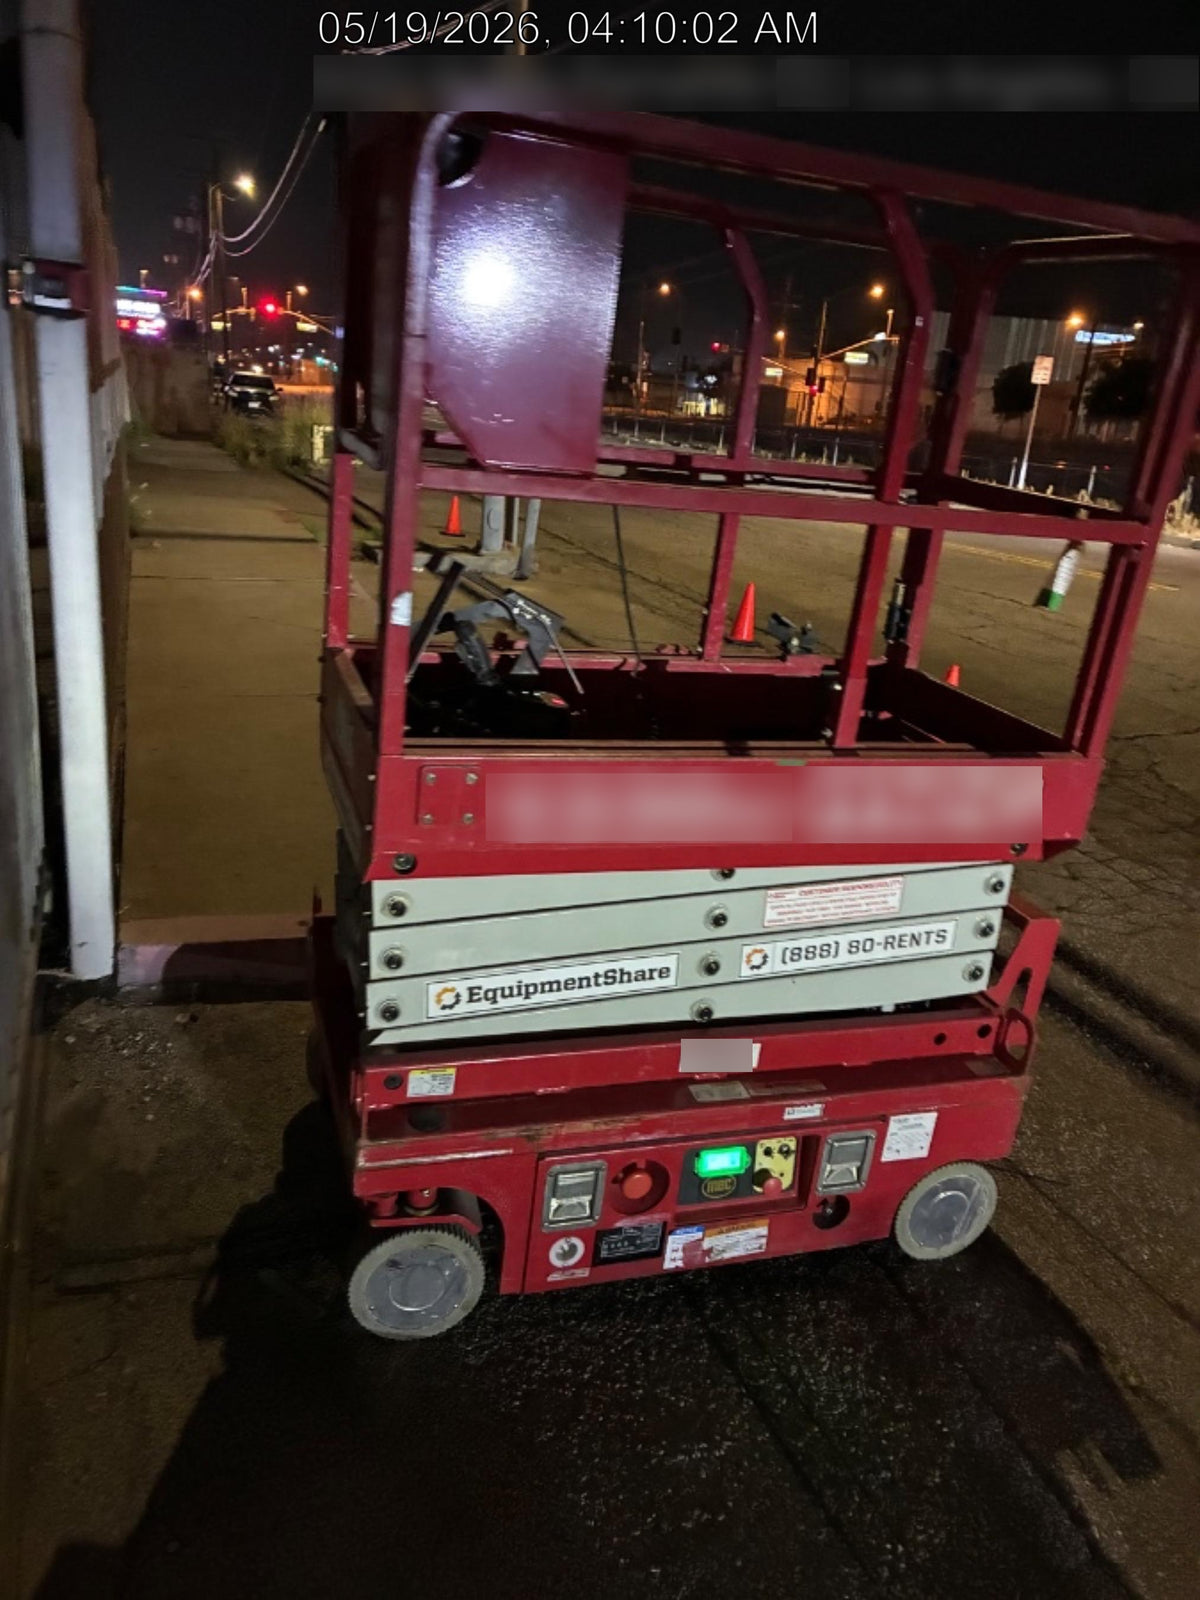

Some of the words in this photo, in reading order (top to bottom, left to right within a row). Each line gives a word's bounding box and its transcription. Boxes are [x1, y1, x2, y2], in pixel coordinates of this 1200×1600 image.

[781, 940, 840, 965] (888)
[847, 928, 948, 955] 80-RENTS
[466, 966, 671, 1004] EquipmentShare
